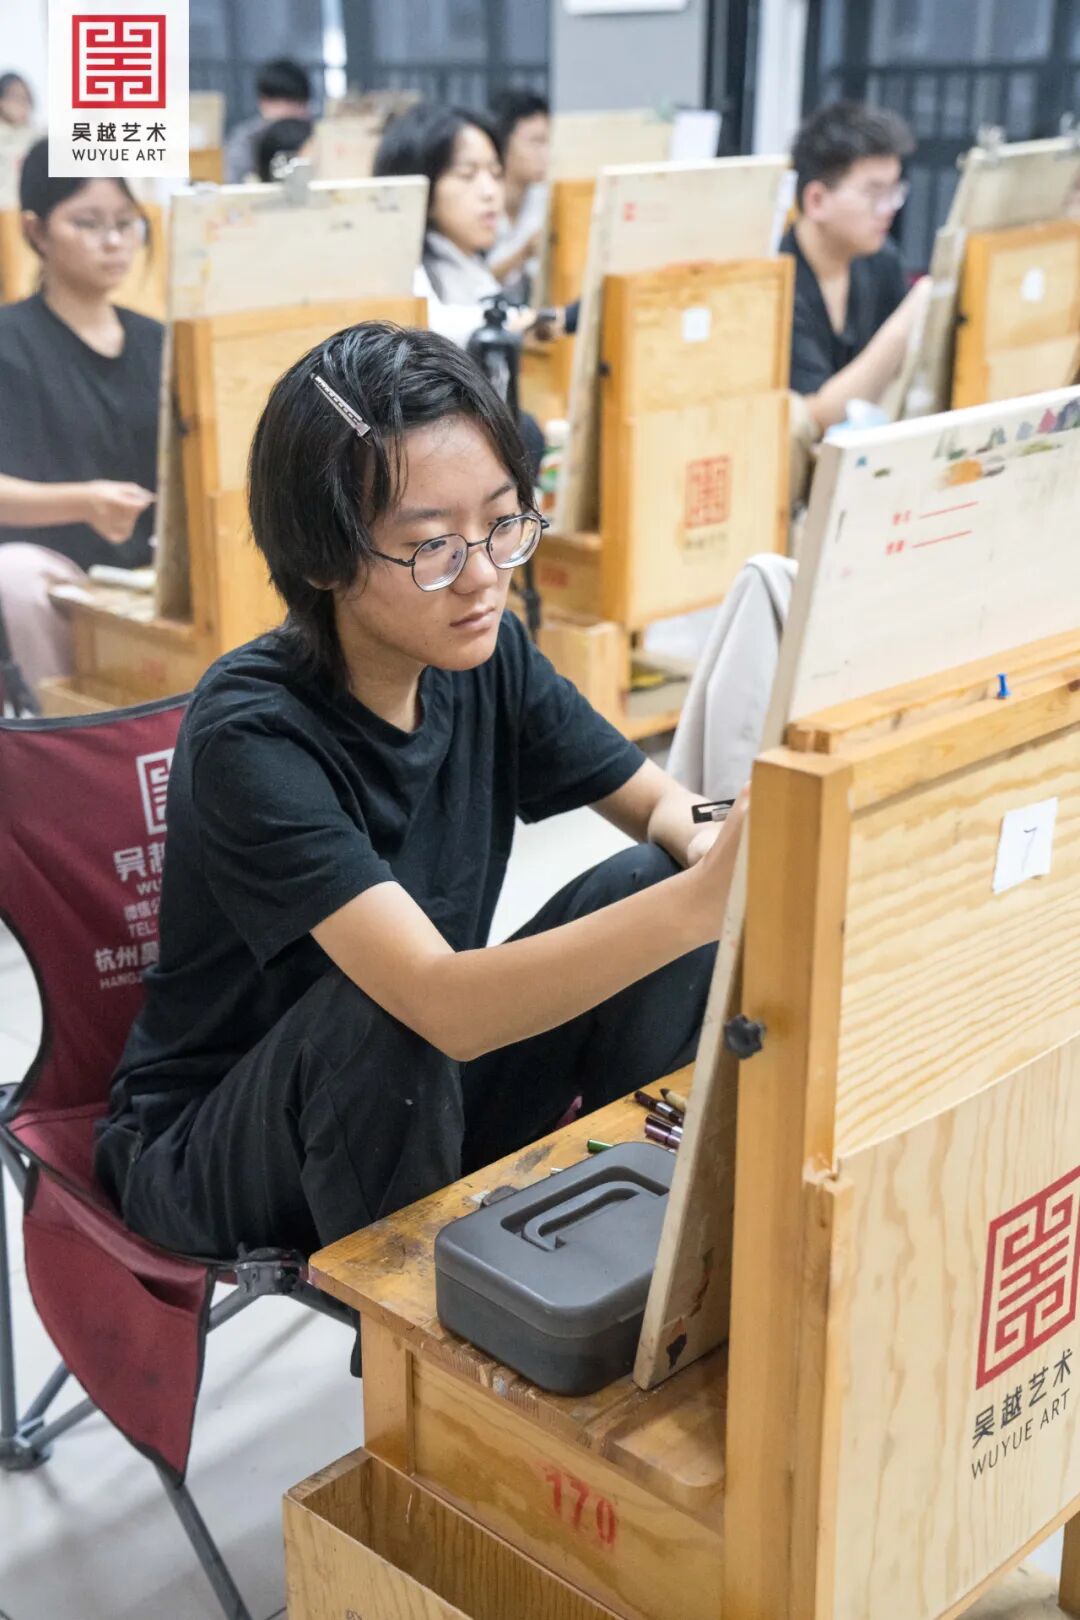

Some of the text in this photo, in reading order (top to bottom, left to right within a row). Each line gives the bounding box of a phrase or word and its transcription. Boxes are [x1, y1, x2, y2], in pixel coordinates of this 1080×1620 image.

[971, 1388, 1070, 1480] WUYUE ART
[972, 1348, 1073, 1449] 吴越艺术
[545, 1472, 617, 1545] 170
